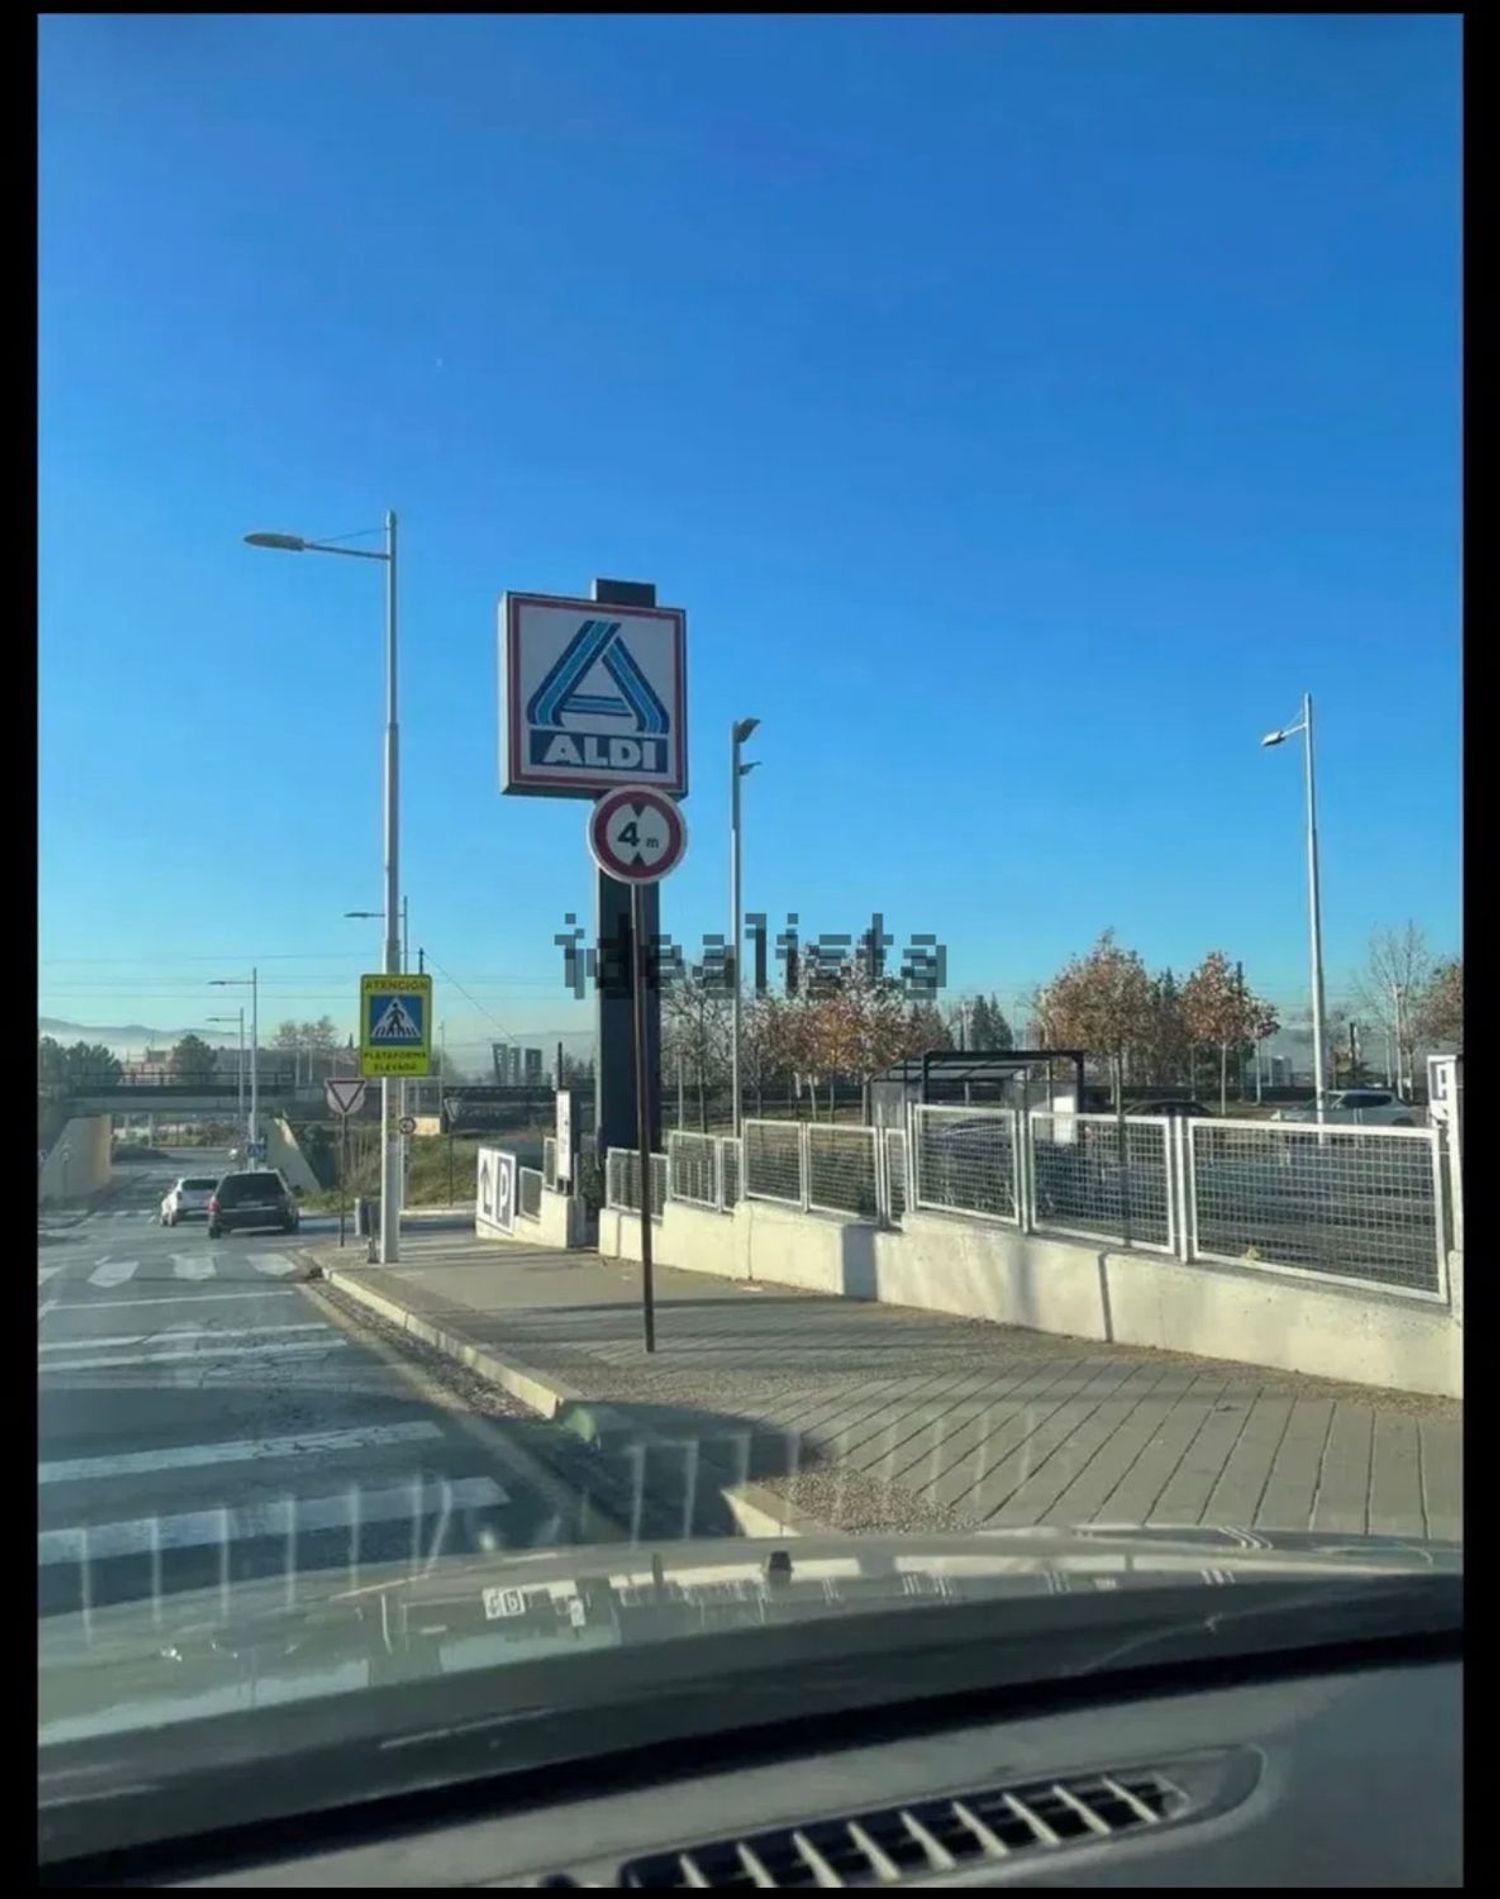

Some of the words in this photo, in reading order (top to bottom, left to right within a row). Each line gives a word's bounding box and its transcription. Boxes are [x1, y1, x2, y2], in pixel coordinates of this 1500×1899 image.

[543, 734, 657, 770] ALDI
[618, 821, 640, 847] 4
[646, 836, 659, 849] m
[499, 1163, 509, 1218] P
